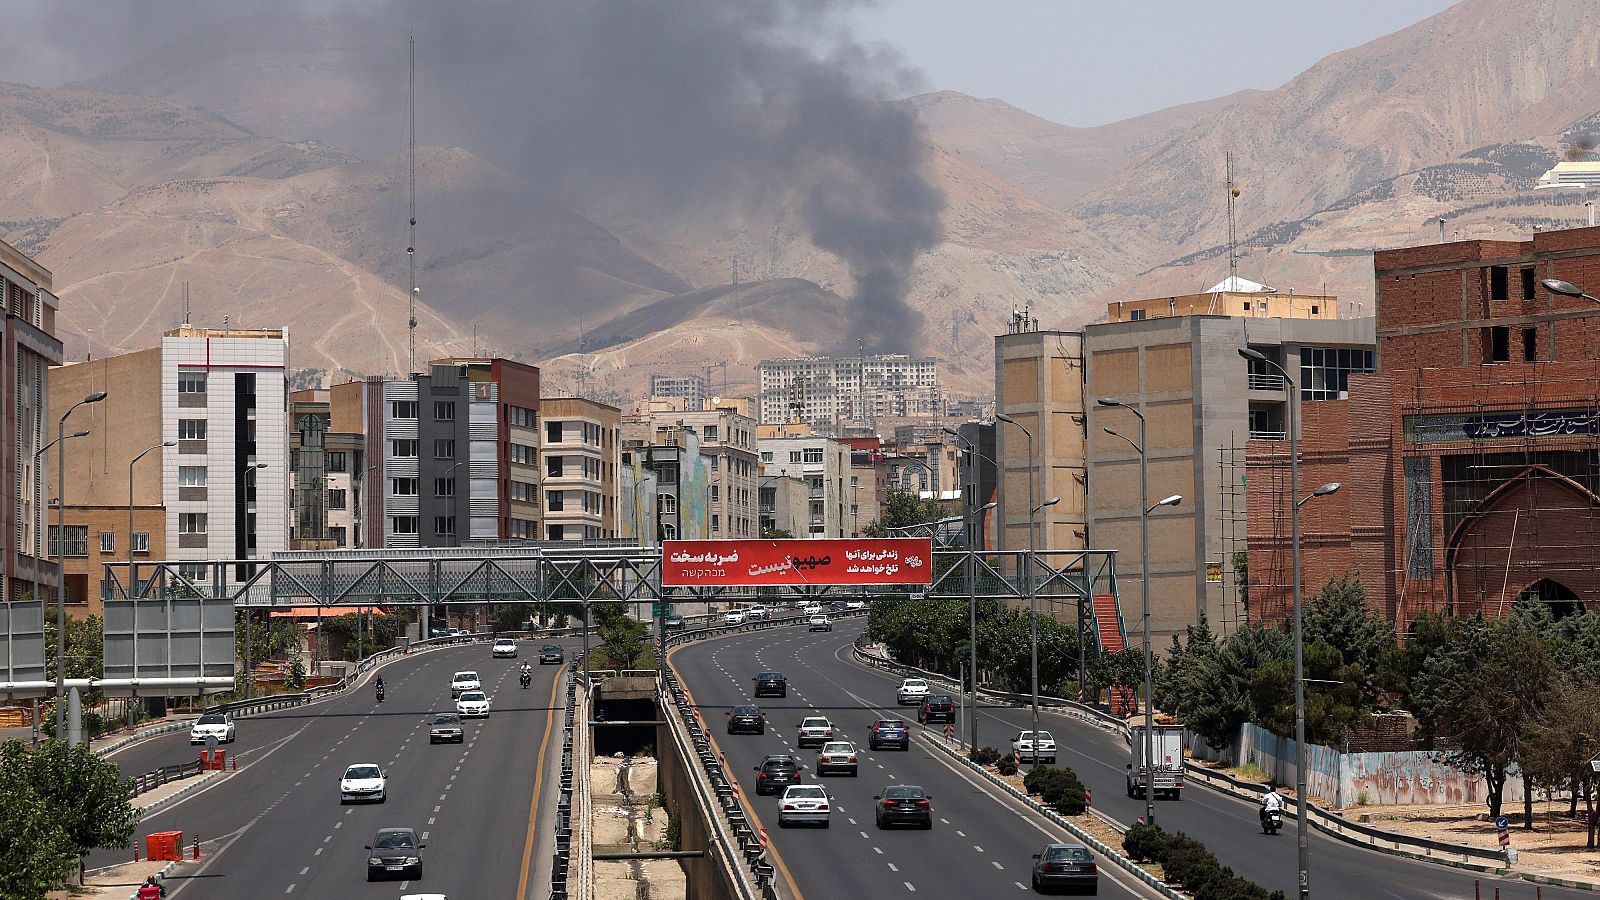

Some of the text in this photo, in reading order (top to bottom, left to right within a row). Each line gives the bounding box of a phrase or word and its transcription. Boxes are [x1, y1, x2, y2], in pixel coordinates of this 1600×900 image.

[670, 549, 739, 566] ضربه سخت
[845, 549, 898, 561] زندگی برای آنها
[846, 563, 899, 576] تلخ خواهد شد
